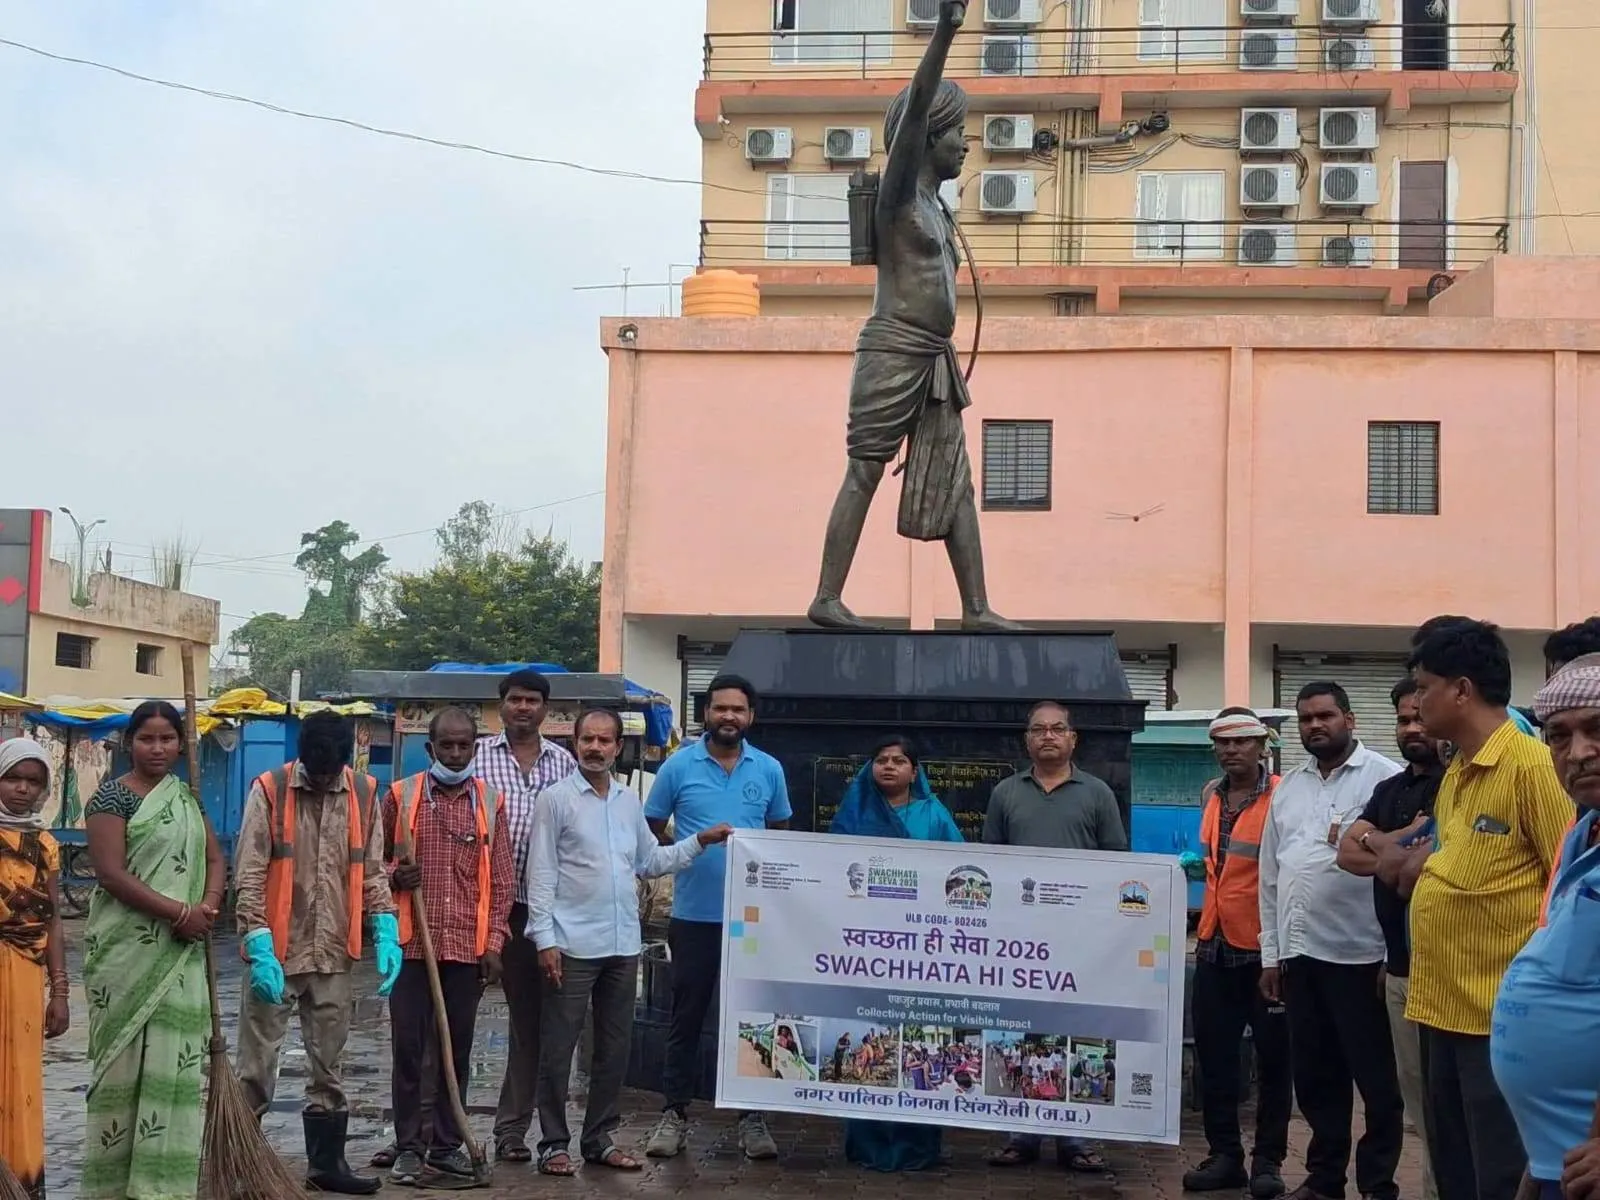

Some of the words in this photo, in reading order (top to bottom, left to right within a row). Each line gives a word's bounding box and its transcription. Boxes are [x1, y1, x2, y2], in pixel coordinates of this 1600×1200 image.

[905, 912, 922, 924] ULB
[954, 915, 988, 928] 802426
[842, 927, 918, 951] स्वच्छता
[923, 928, 944, 955] ही
[949, 928, 990, 957] सेवा
[995, 938, 1050, 961] 2026
[814, 952, 972, 984] SWACHHATA
[979, 965, 1004, 986] HI
[1011, 967, 1078, 993] SEVA
[856, 1006, 906, 1019] Collective
[908, 1010, 941, 1023] Action
[943, 1012, 957, 1024] for
[960, 1014, 994, 1026] Visible
[996, 1017, 1032, 1030] Impact
[887, 994, 916, 1009] एकजुट
[971, 1001, 1001, 1013] बदलाव
[793, 1085, 834, 1102] नगर
[837, 1086, 894, 1108] पालिक
[897, 1089, 949, 1113] निगम
[954, 1094, 1030, 1119] सिंगरौली
[1034, 1103, 1092, 1125] (म.प्र.)
